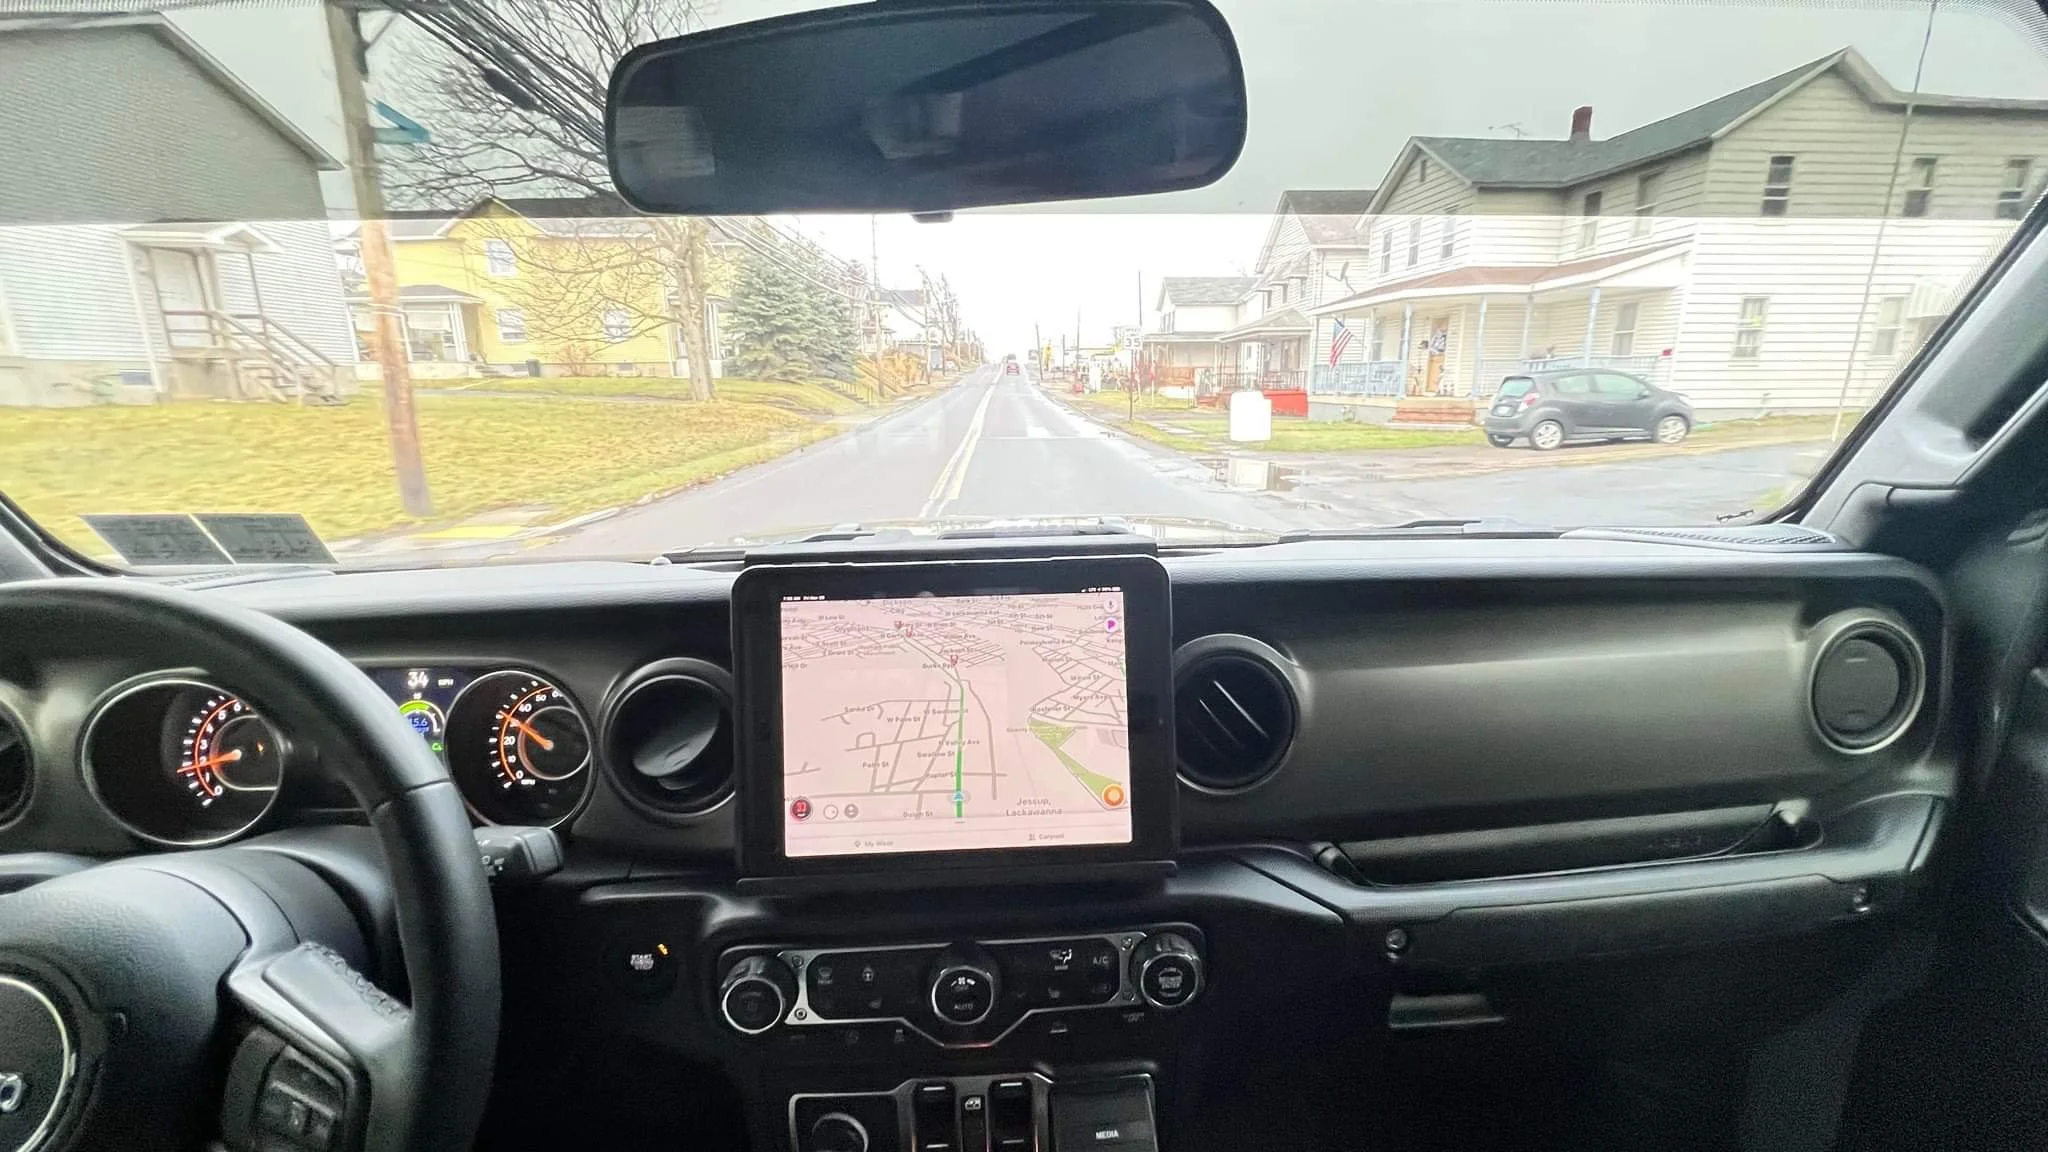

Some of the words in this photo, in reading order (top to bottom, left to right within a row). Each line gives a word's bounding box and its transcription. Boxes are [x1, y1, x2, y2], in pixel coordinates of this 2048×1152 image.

[1125, 337, 1141, 347] 35
[407, 671, 429, 687] 34
[234, 702, 241, 712] 6
[519, 703, 532, 712] 40
[218, 710, 227, 720] 5
[206, 724, 214, 733] 4
[200, 739, 208, 750] 3
[504, 736, 516, 745] 20
[507, 755, 516, 763] 10
[516, 770, 523, 779] 0
[214, 785, 223, 796] 0
[1006, 808, 1062, 817] Lackawanna
[1093, 956, 1109, 966] A/C
[1095, 1129, 1119, 1140] MEDIA
